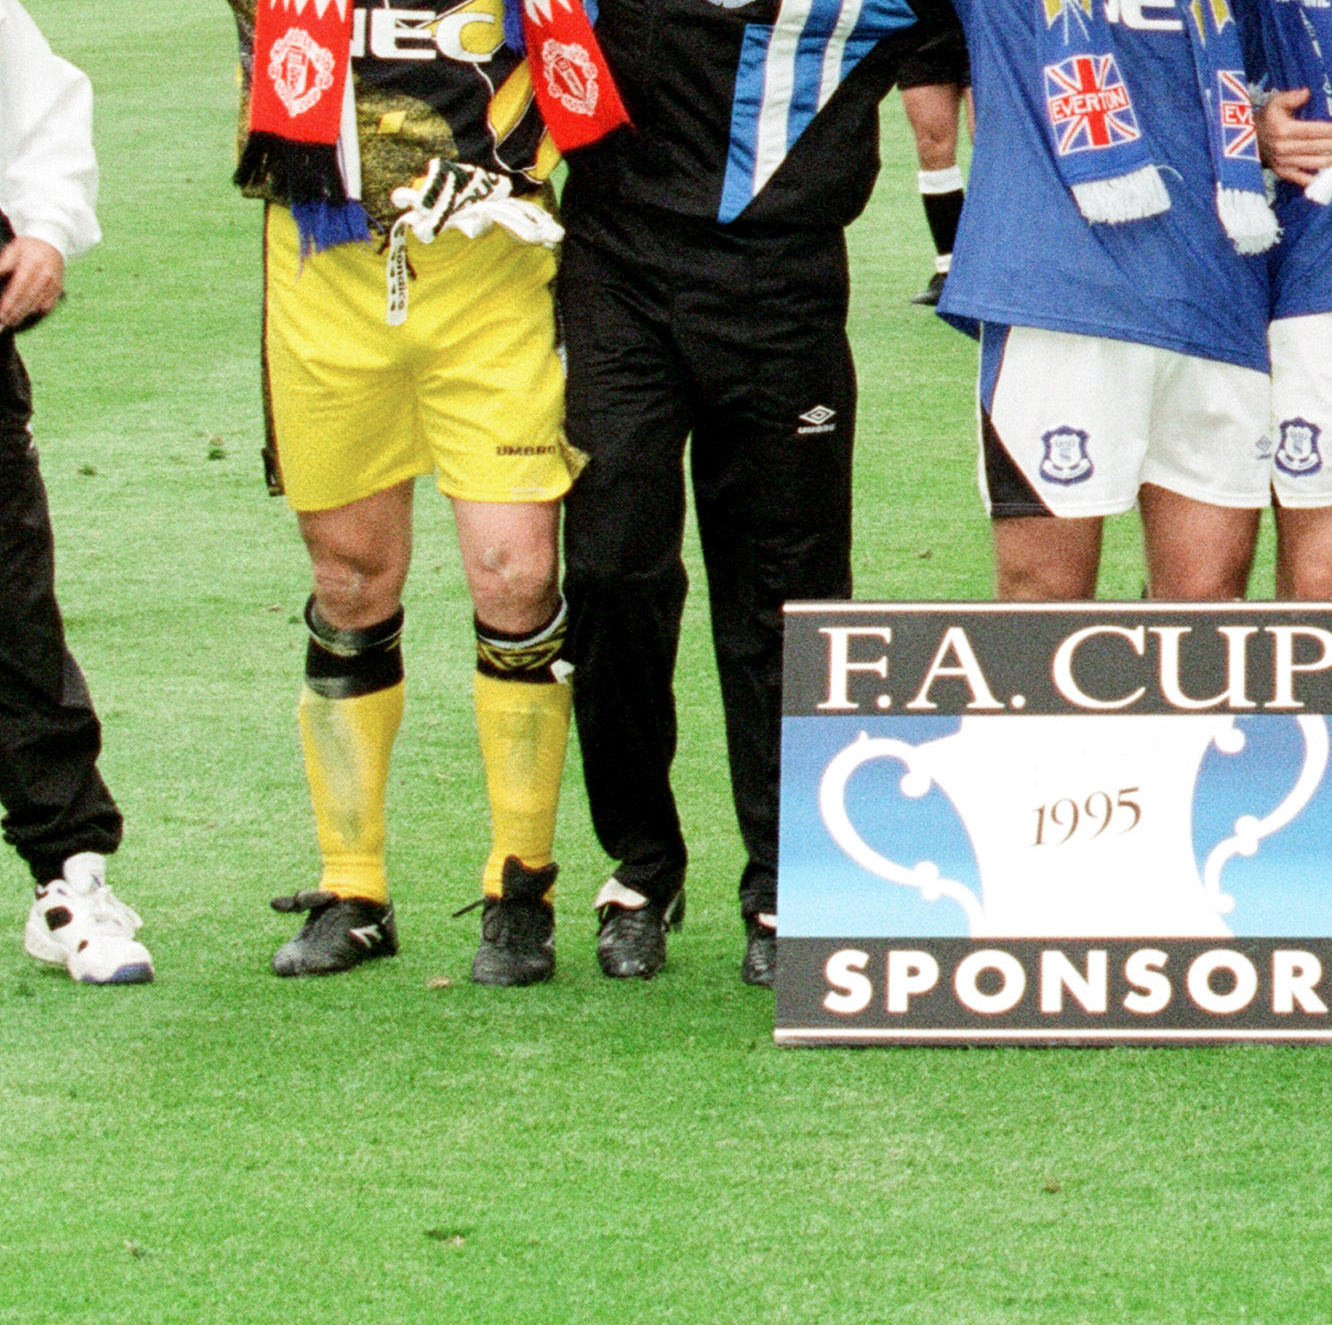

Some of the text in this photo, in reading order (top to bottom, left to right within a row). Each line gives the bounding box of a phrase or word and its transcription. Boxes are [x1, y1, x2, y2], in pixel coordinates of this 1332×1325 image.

[1051, 85, 1130, 122] EVERTON
[496, 444, 558, 456] UMBRO
[817, 626, 1026, 710] F.A.
[1029, 785, 1144, 848] 1995
[822, 948, 1330, 1014] SPONSOR
